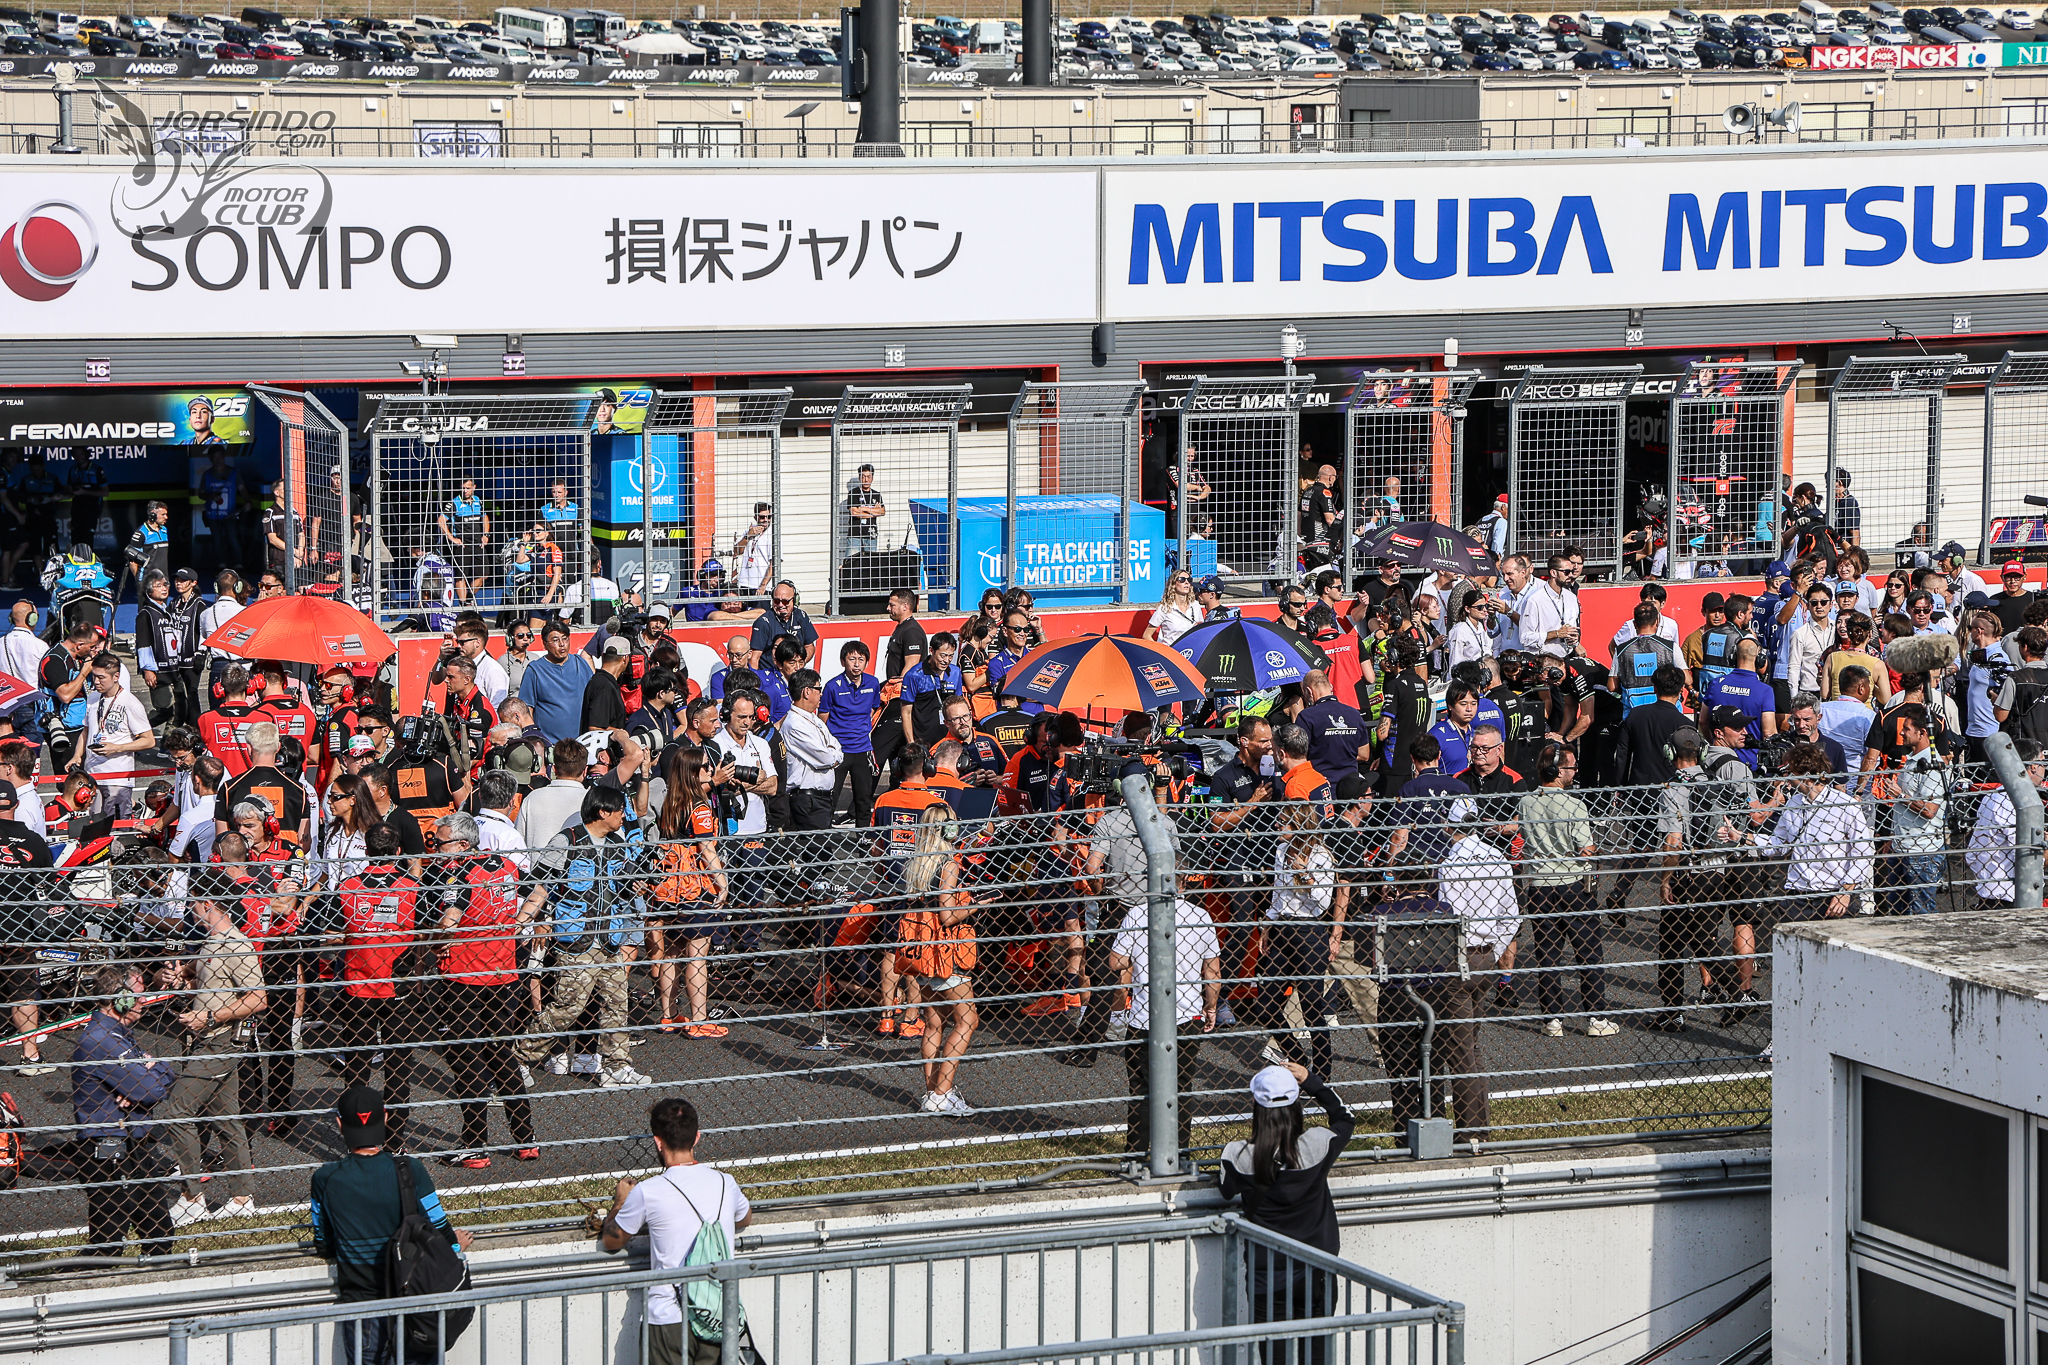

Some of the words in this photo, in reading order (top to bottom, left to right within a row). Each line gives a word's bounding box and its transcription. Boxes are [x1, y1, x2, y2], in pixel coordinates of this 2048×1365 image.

[1813, 47, 1867, 67] NGK
[1901, 46, 1957, 67] NGK
[126, 62, 178, 74] MotoGP
[208, 63, 259, 75] MotoGP
[368, 65, 419, 77] MotoGP
[448, 66, 500, 78] MotoGP
[608, 69, 660, 80] MotoGP
[768, 69, 819, 80] MotoGP
[1129, 196, 1614, 284] MITSUBA
[605, 217, 963, 284] 損保ジャパン
[132, 226, 451, 291] SOMPO
[1953, 317, 1970, 328] 21
[1626, 330, 1643, 342] 20
[1295, 339, 1305, 352] 9
[886, 349, 904, 363] 18
[88, 363, 107, 377] 16
[505, 357, 524, 371] 17
[1578, 379, 1699, 397] BEZZECCI
[616, 389, 654, 409] 79
[214, 397, 250, 417] 25
[802, 405, 851, 415] ONLYFAS
[945, 401, 973, 411] TEM
[1712, 418, 1737, 434] 72
[106, 445, 147, 459] TEAM
[620, 496, 674, 506] TRACOUSE
[627, 528, 667, 541] OGRA
[74, 569, 98, 581] 25
[1023, 564, 1097, 585] MOTOGP
[1267, 667, 1301, 680] YAMAHA
[999, 728, 1025, 741] ÖHLIN
[374, 905, 395, 913] Lenovo
